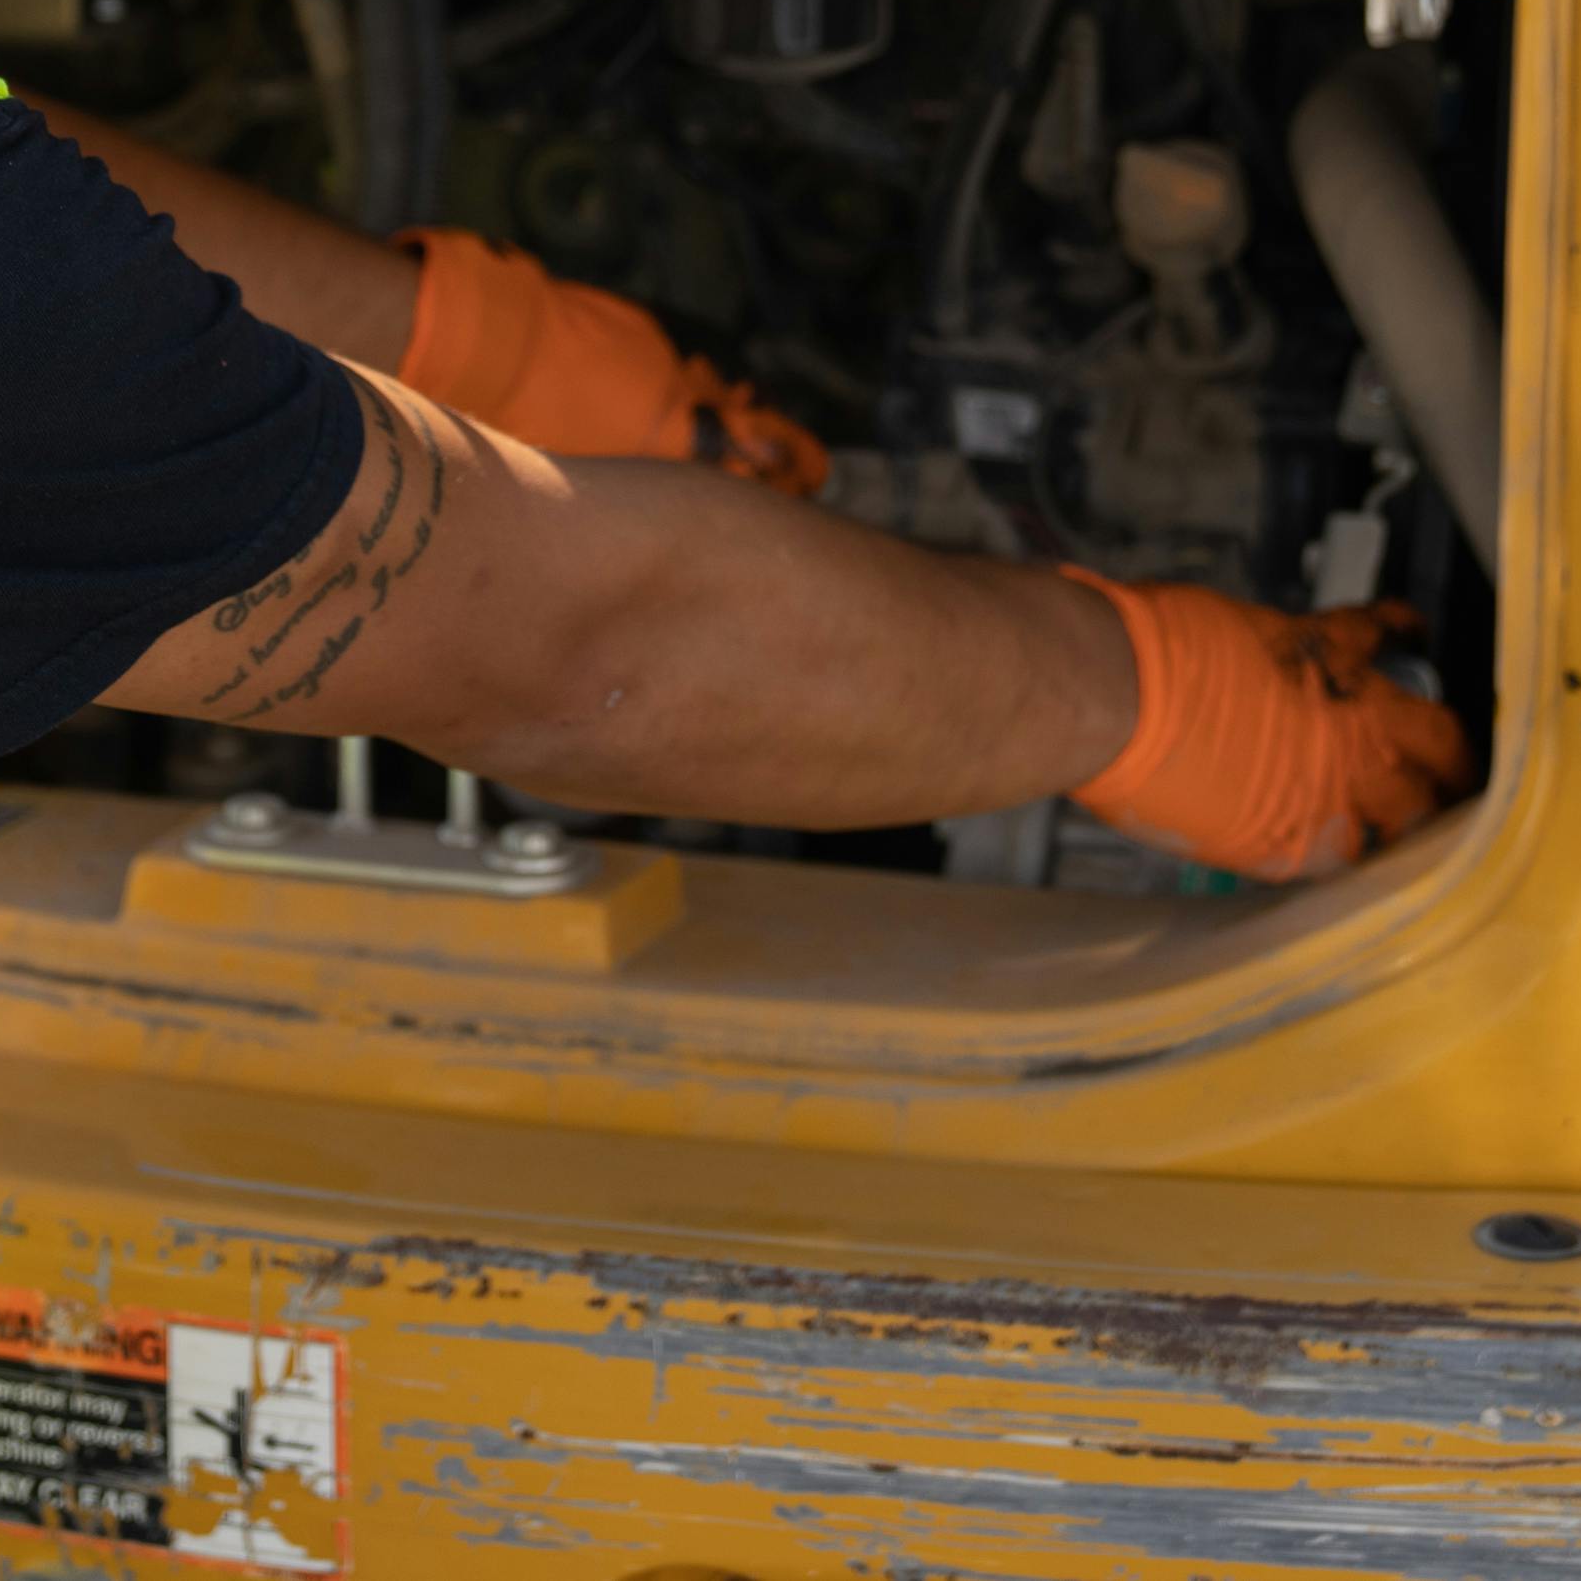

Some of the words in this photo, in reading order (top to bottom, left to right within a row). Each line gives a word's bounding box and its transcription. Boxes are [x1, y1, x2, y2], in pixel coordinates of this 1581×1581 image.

[68, 1392, 129, 1426] may
[32, 1415, 65, 1439] or
[66, 1421, 165, 1457] reverse
[37, 1478, 148, 1523] CEAR
